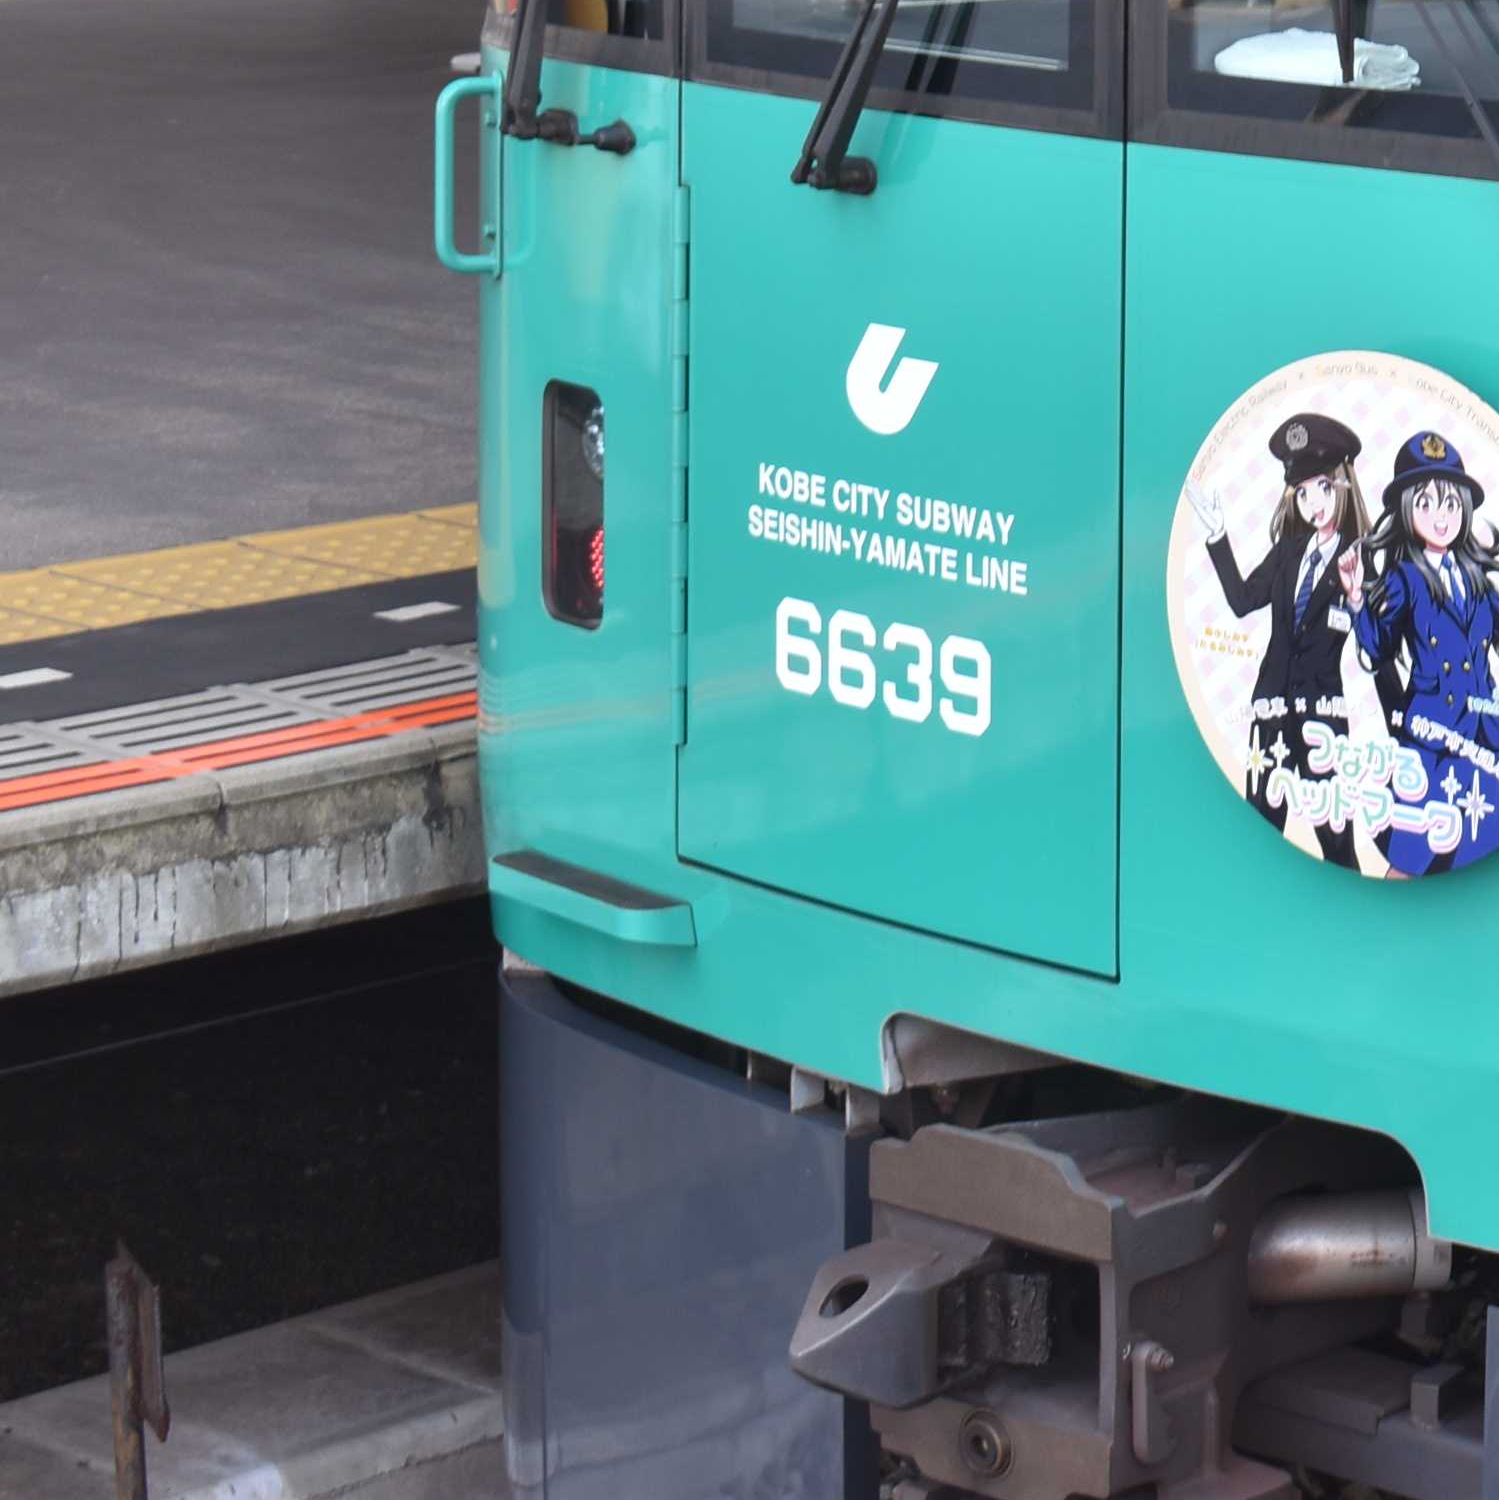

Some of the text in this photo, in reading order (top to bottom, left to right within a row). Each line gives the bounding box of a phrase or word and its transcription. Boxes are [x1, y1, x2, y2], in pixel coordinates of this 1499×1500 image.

[758, 462, 1015, 545] KOBE CITY SUBWAY
[748, 504, 1028, 595] SEISHIN-YAMATE LINE
[775, 596, 992, 737] 6639
[1302, 720, 1429, 803] つながる
[1266, 767, 1463, 854] ヘッドマーク
